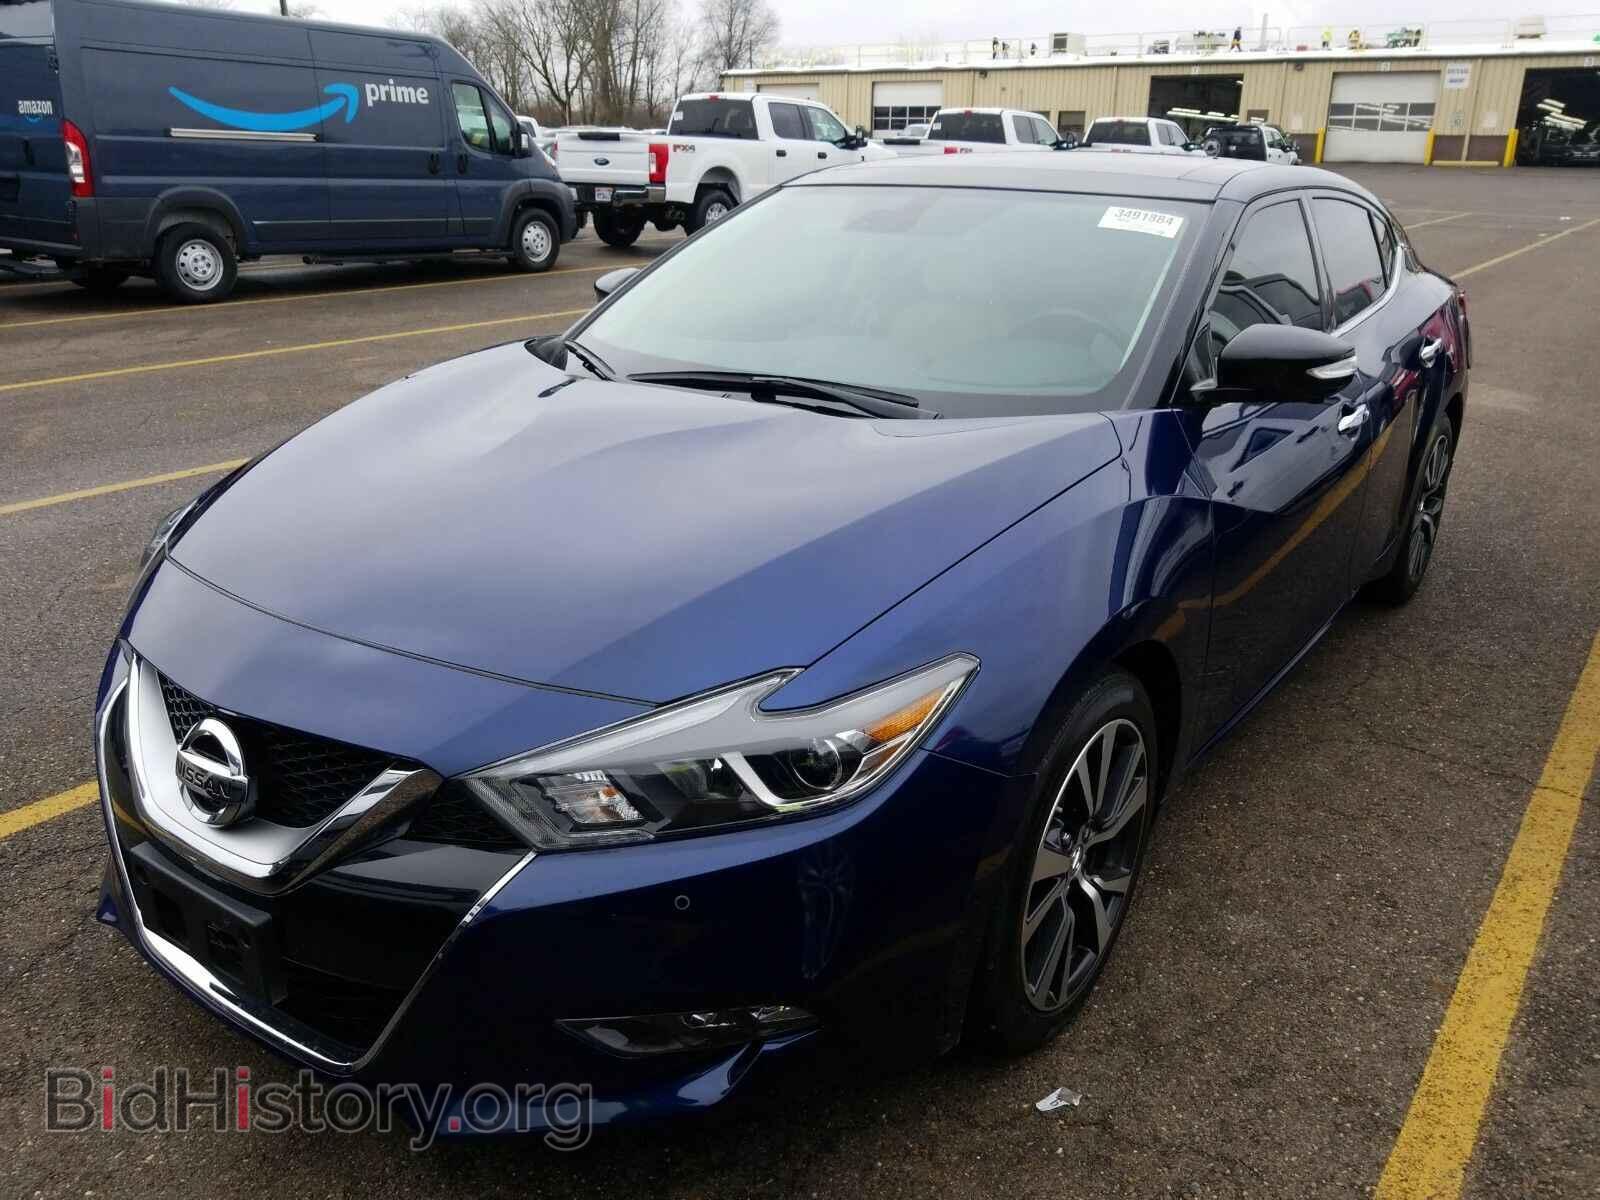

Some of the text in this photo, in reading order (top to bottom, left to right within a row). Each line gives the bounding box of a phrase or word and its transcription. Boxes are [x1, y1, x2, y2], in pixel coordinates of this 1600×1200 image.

[365, 79, 430, 107] prime
[18, 100, 53, 115] amazon
[673, 144, 696, 153] FX4
[176, 758, 232, 802] NISSAN
